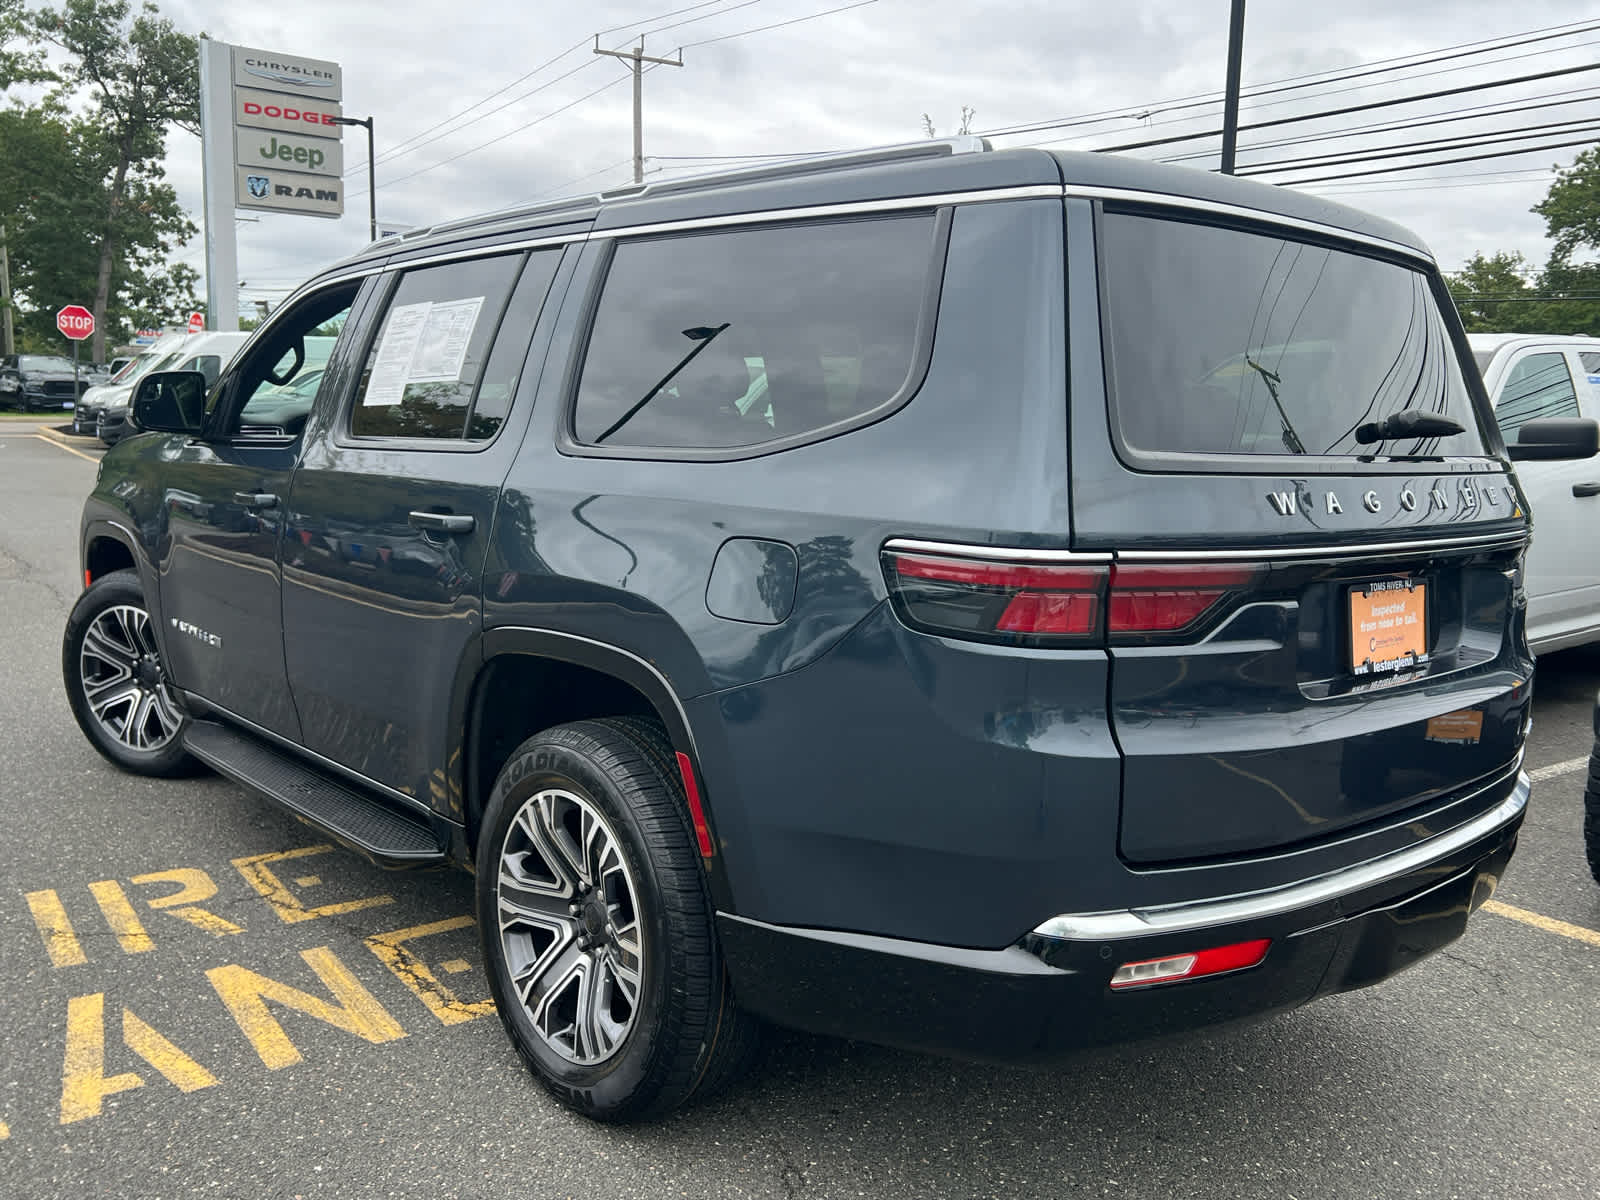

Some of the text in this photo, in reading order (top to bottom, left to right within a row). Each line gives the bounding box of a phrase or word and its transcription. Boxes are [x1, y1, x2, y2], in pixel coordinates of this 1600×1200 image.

[245, 59, 333, 79] CHRYSLER
[243, 102, 337, 126] DODGE
[259, 137, 324, 169] Jeep
[274, 184, 338, 201] RAM
[60, 314, 92, 329] STOP
[1265, 485, 1520, 516] WAGONEER
[1370, 582, 1386, 592] TOMS
[1373, 657, 1413, 672] lesterglenn
[0, 915, 498, 1140] ANE
